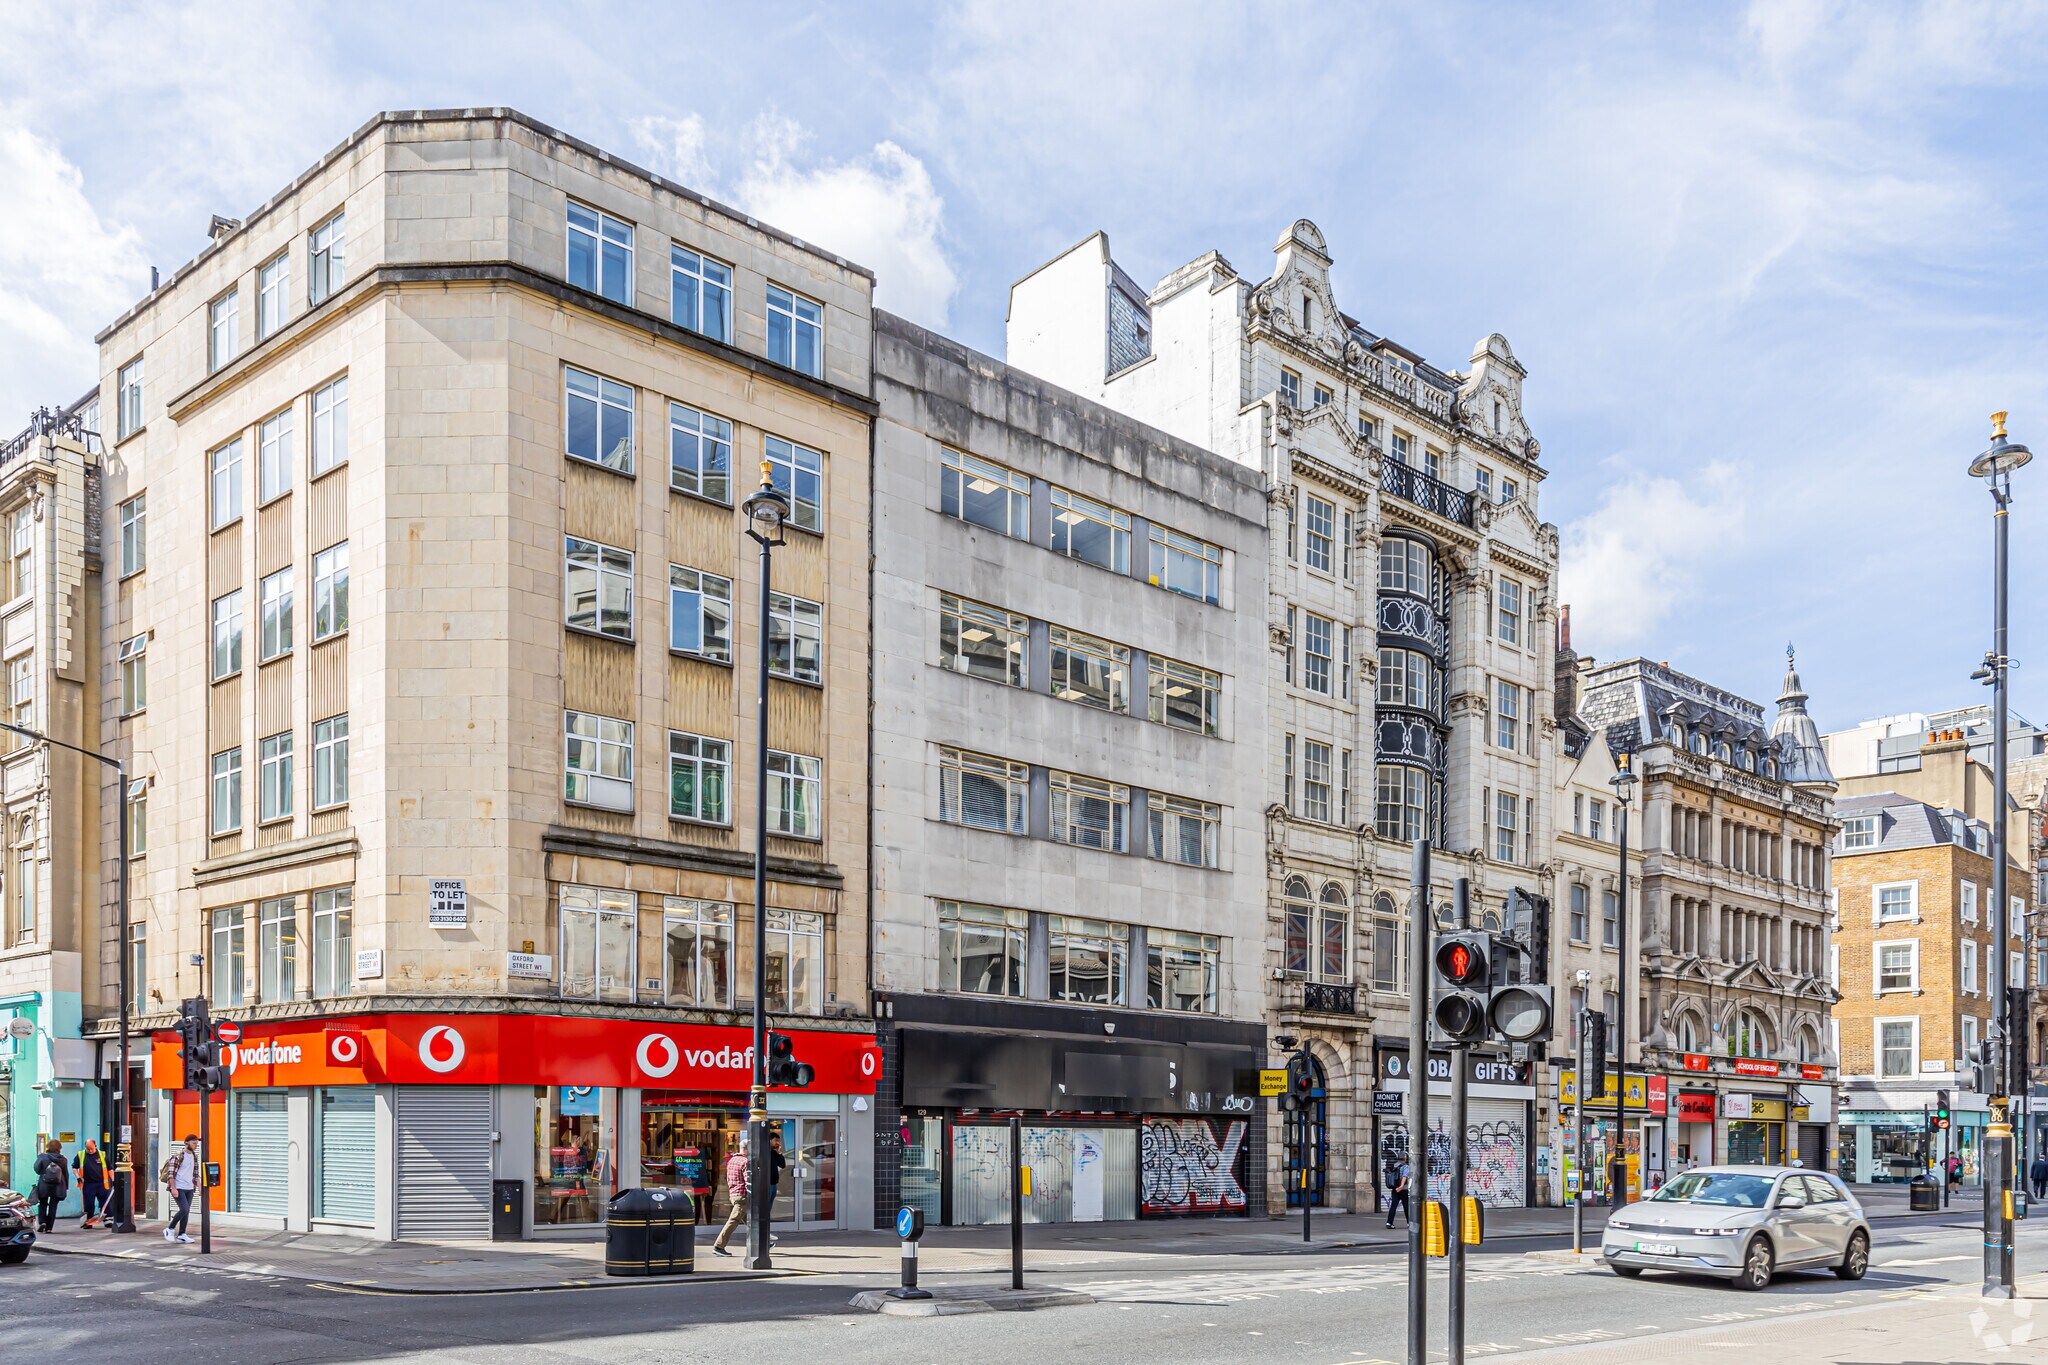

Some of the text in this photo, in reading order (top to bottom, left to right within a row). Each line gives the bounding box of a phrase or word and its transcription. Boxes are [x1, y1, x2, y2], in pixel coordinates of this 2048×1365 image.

[434, 881, 462, 889] OFFICE
[432, 890, 465, 899] TO LET
[512, 955, 535, 963] OXFORD
[512, 962, 532, 970] STREET
[239, 1041, 302, 1066] vodafone
[684, 1046, 795, 1069] vodaf
[1475, 1062, 1517, 1081] GIFTS
[1737, 1062, 1755, 1071] SCHOOL
[1760, 1065, 1777, 1073] ENGLISH
[1264, 1075, 1283, 1083] Money
